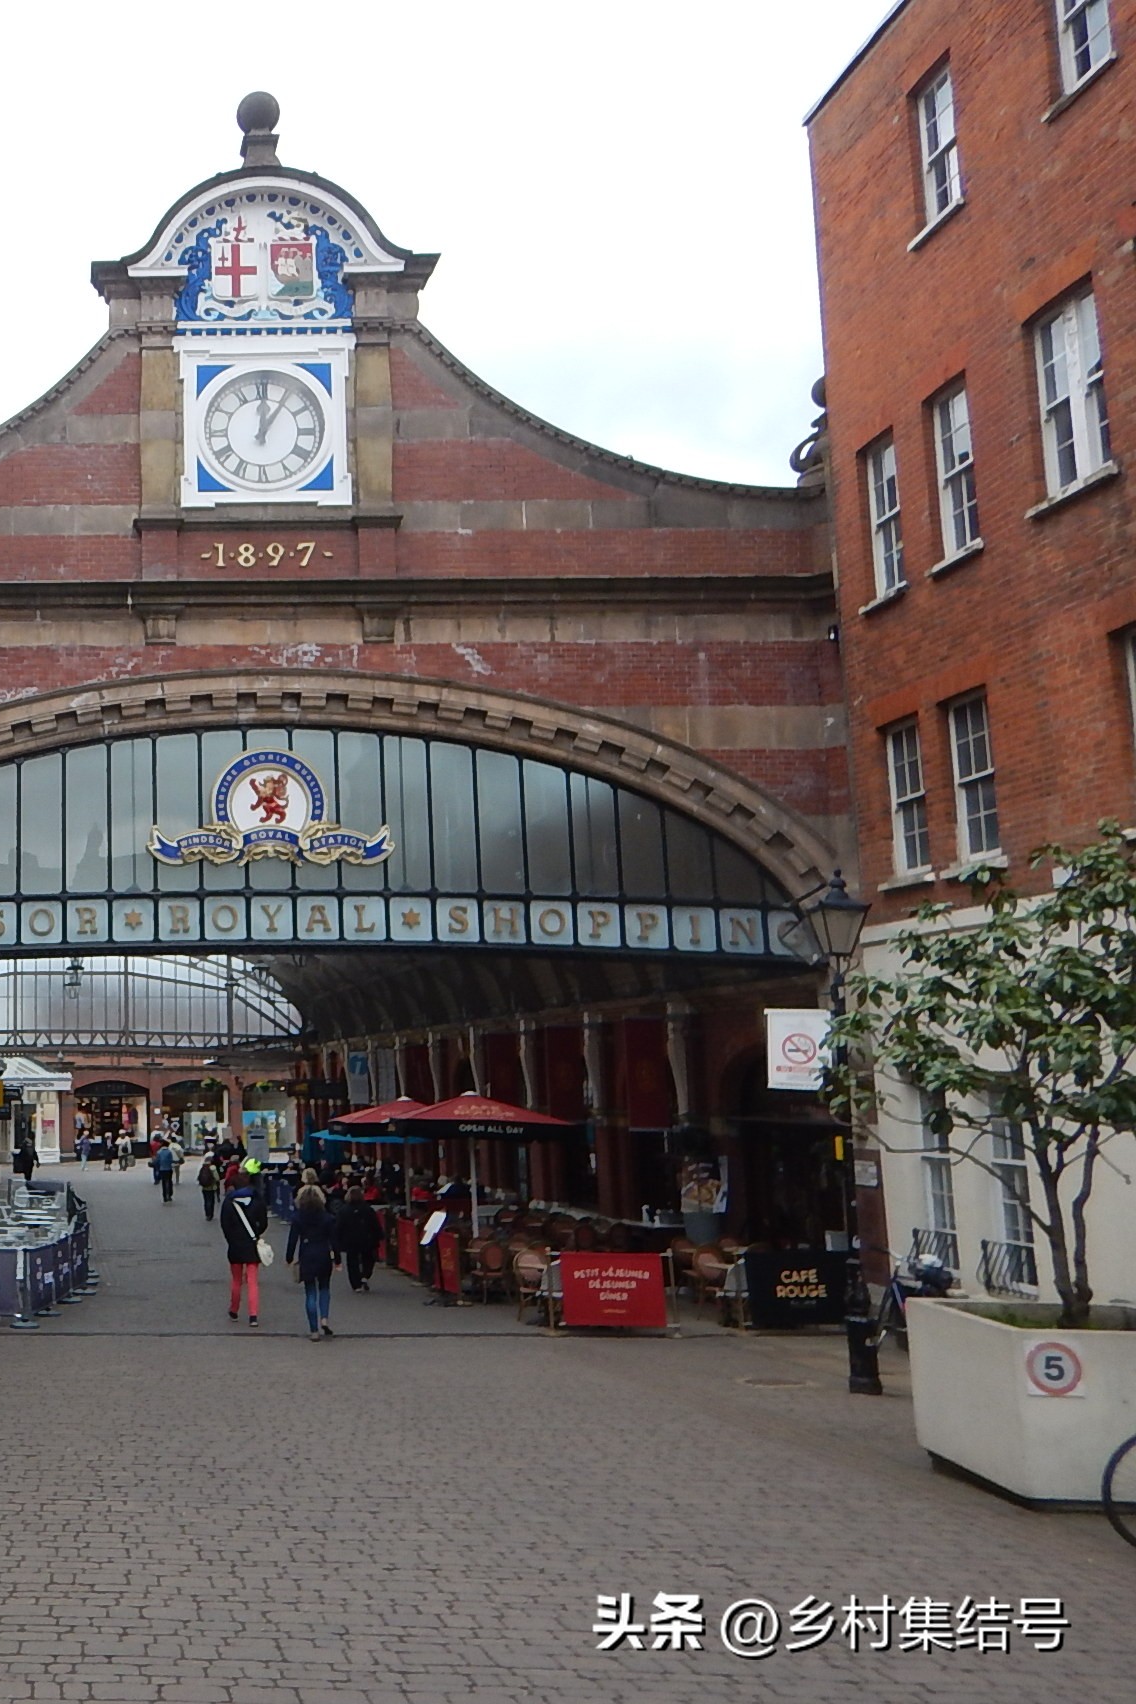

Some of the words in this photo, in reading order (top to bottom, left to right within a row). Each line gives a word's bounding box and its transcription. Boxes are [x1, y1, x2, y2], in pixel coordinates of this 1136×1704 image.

[179, 835, 232, 849] WINDSOR
[250, 830, 292, 842] ROYAL
[312, 836, 366, 850] STATION
[169, 902, 377, 935] ROYAL
[458, 1123, 485, 1133] OPEN
[487, 1125, 504, 1134] ALL
[505, 1126, 524, 1135] DAY
[573, 1268, 600, 1280] PETIT
[775, 1284, 829, 1299] ROUGE
[1044, 1355, 1065, 1382] 5
